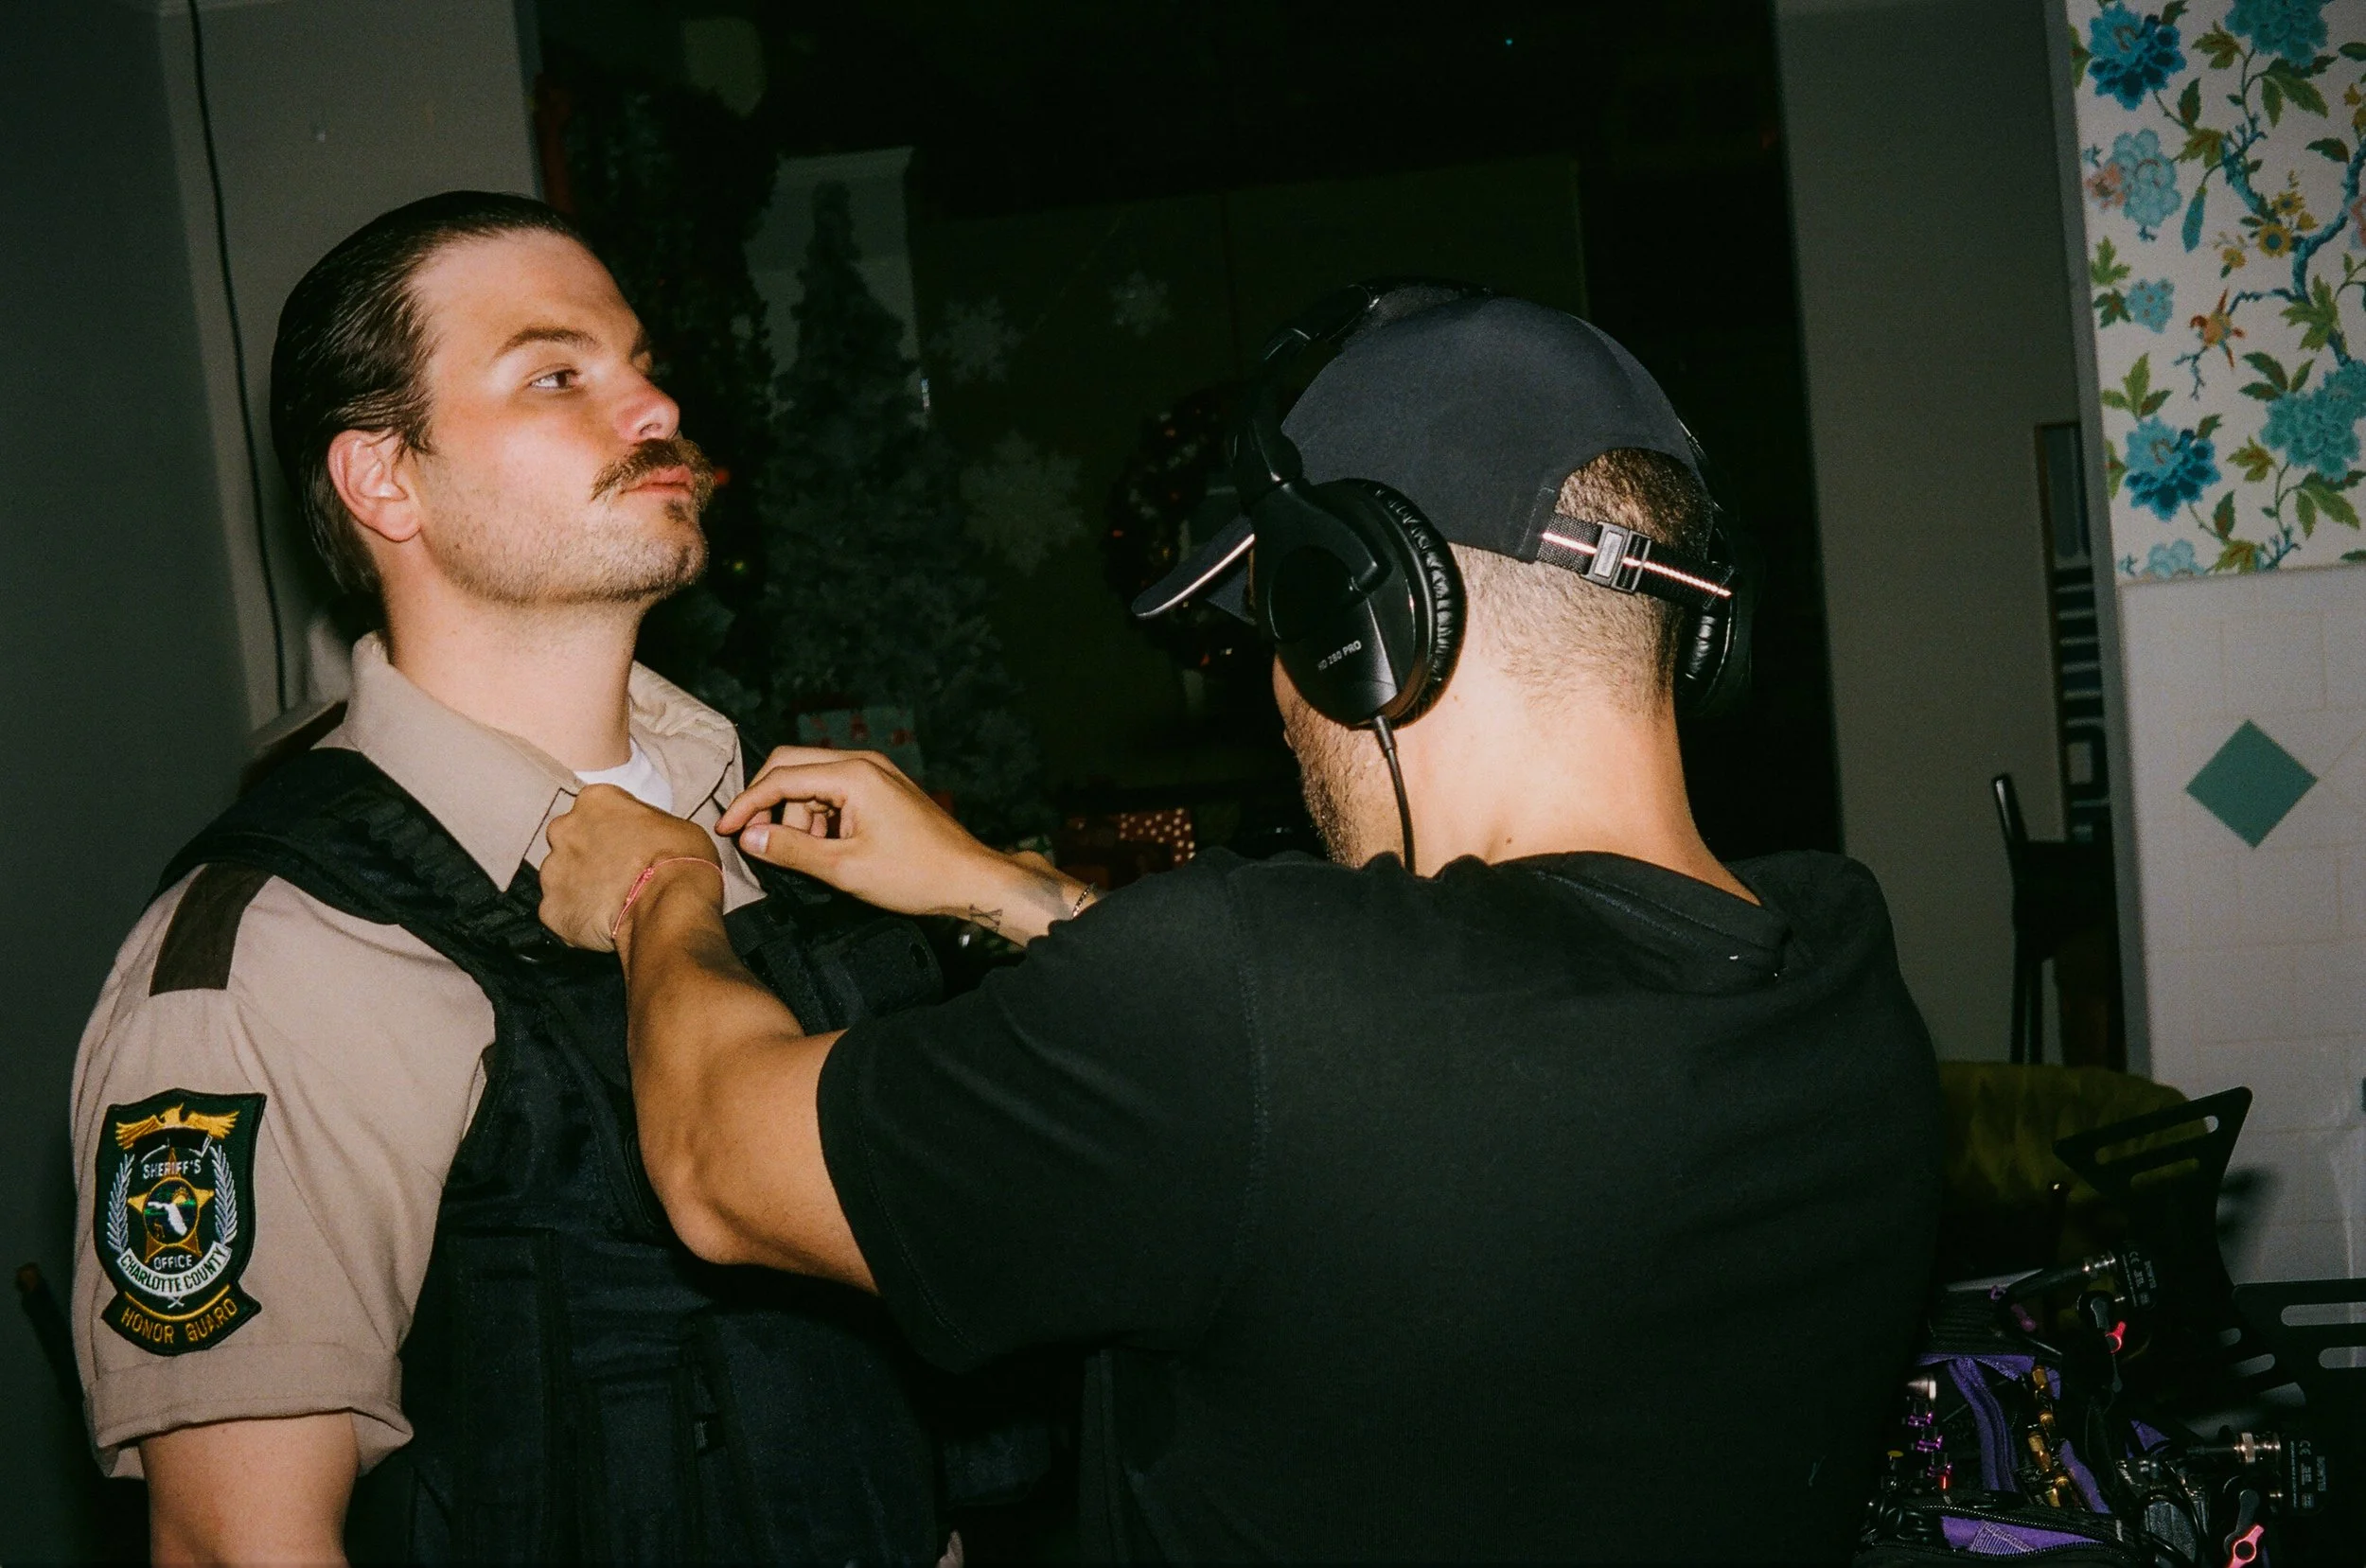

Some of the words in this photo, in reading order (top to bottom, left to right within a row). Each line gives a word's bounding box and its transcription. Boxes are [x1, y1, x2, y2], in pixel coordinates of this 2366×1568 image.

[1342, 640, 1362, 656] PRO
[143, 1159, 203, 1180] SHERIFF'S
[120, 1253, 184, 1294] CHARLOTTE
[183, 1247, 227, 1290] COUNTY
[153, 1254, 193, 1270] OFFICE
[121, 1307, 174, 1344] HONOR
[185, 1297, 238, 1343] GUARD
